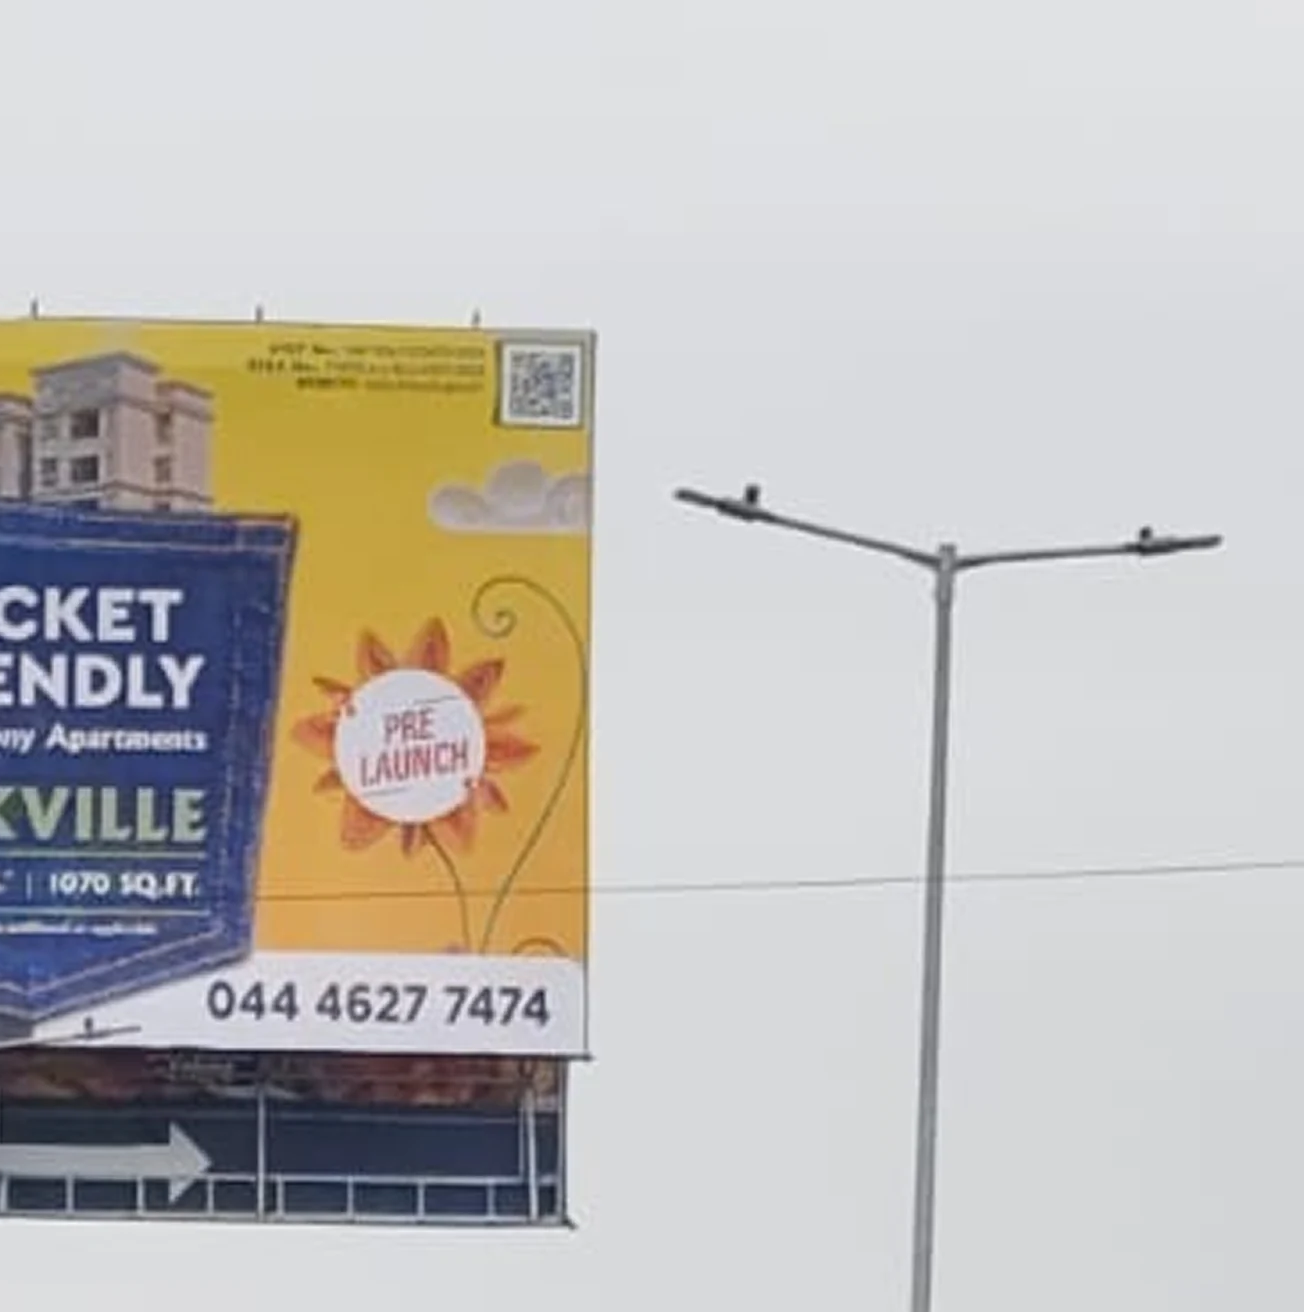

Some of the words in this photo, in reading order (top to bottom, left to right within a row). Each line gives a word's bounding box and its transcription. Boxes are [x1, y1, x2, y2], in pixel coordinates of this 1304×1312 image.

[46, 724, 208, 752] Apartments
[383, 707, 437, 743] PRE
[359, 740, 470, 786] LAUNCH
[50, 873, 111, 894] 1070
[207, 981, 298, 1020] 044
[316, 983, 428, 1024] 4627
[442, 985, 552, 1028] 7474
